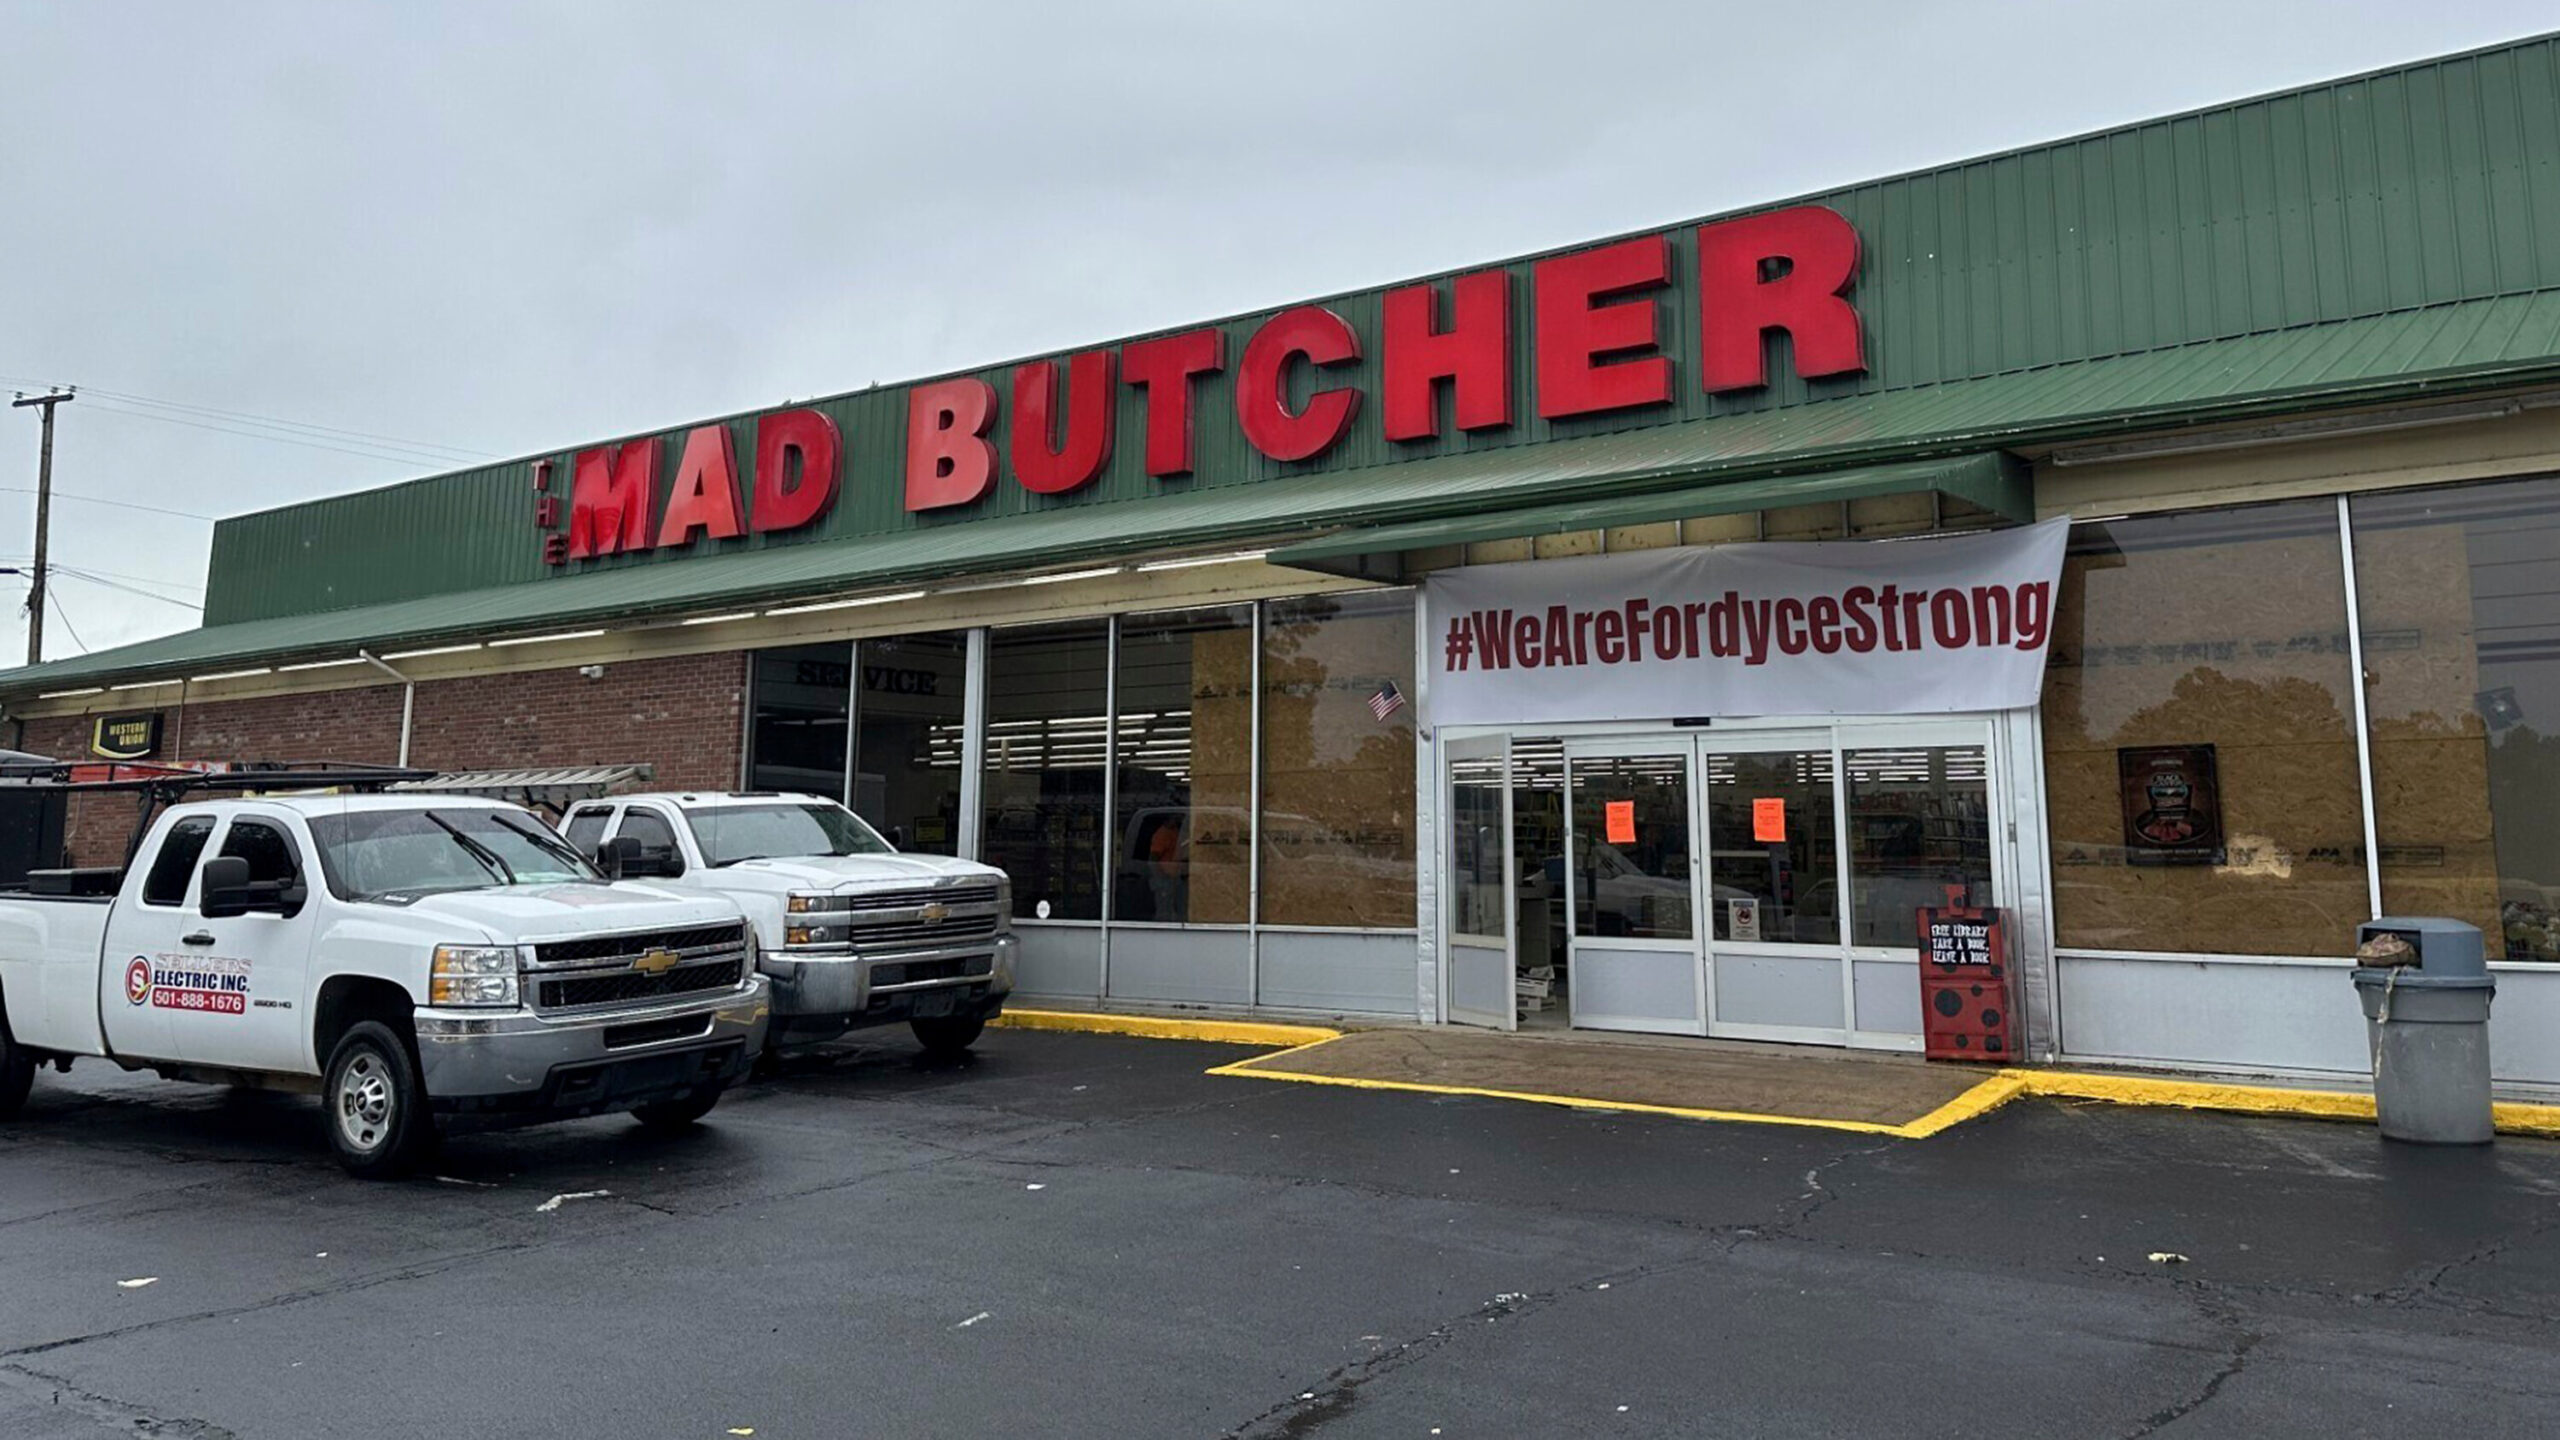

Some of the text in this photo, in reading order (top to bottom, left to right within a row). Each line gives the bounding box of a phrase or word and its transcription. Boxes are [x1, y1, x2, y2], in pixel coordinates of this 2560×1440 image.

[568, 204, 1868, 560] MAD BUTCHER
[531, 458, 568, 566] THE
[1445, 580, 2051, 672] #WeAreFordyceStrong
[109, 722, 147, 736] WESTERN
[119, 733, 146, 746] UNION
[1931, 924, 1988, 937] FREE LIBRARY
[1932, 937, 1954, 949] TAKE
[1957, 938, 1964, 950] A
[155, 953, 252, 974] SELLERS
[1932, 950, 1990, 964] LEAVE A BOOK
[154, 970, 251, 992] ELECTRIC INC.
[155, 990, 242, 1011] 501-888-1676
